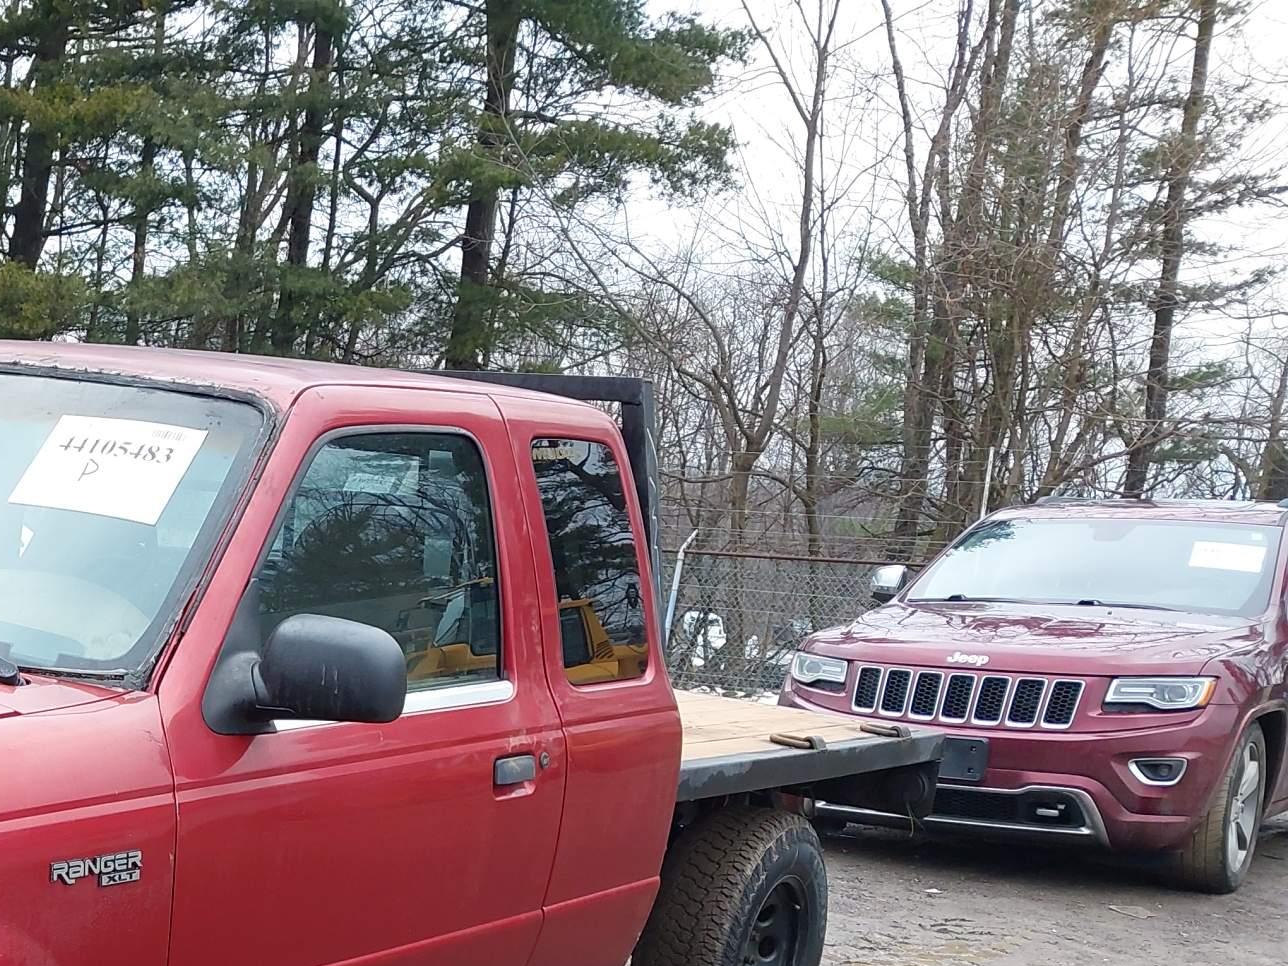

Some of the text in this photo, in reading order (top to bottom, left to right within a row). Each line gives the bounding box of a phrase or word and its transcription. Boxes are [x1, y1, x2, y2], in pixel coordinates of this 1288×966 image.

[58, 436, 174, 465] 44105483
[946, 651, 990, 667] Jeep
[50, 850, 143, 885] RANGER
[103, 870, 139, 886] XLT
